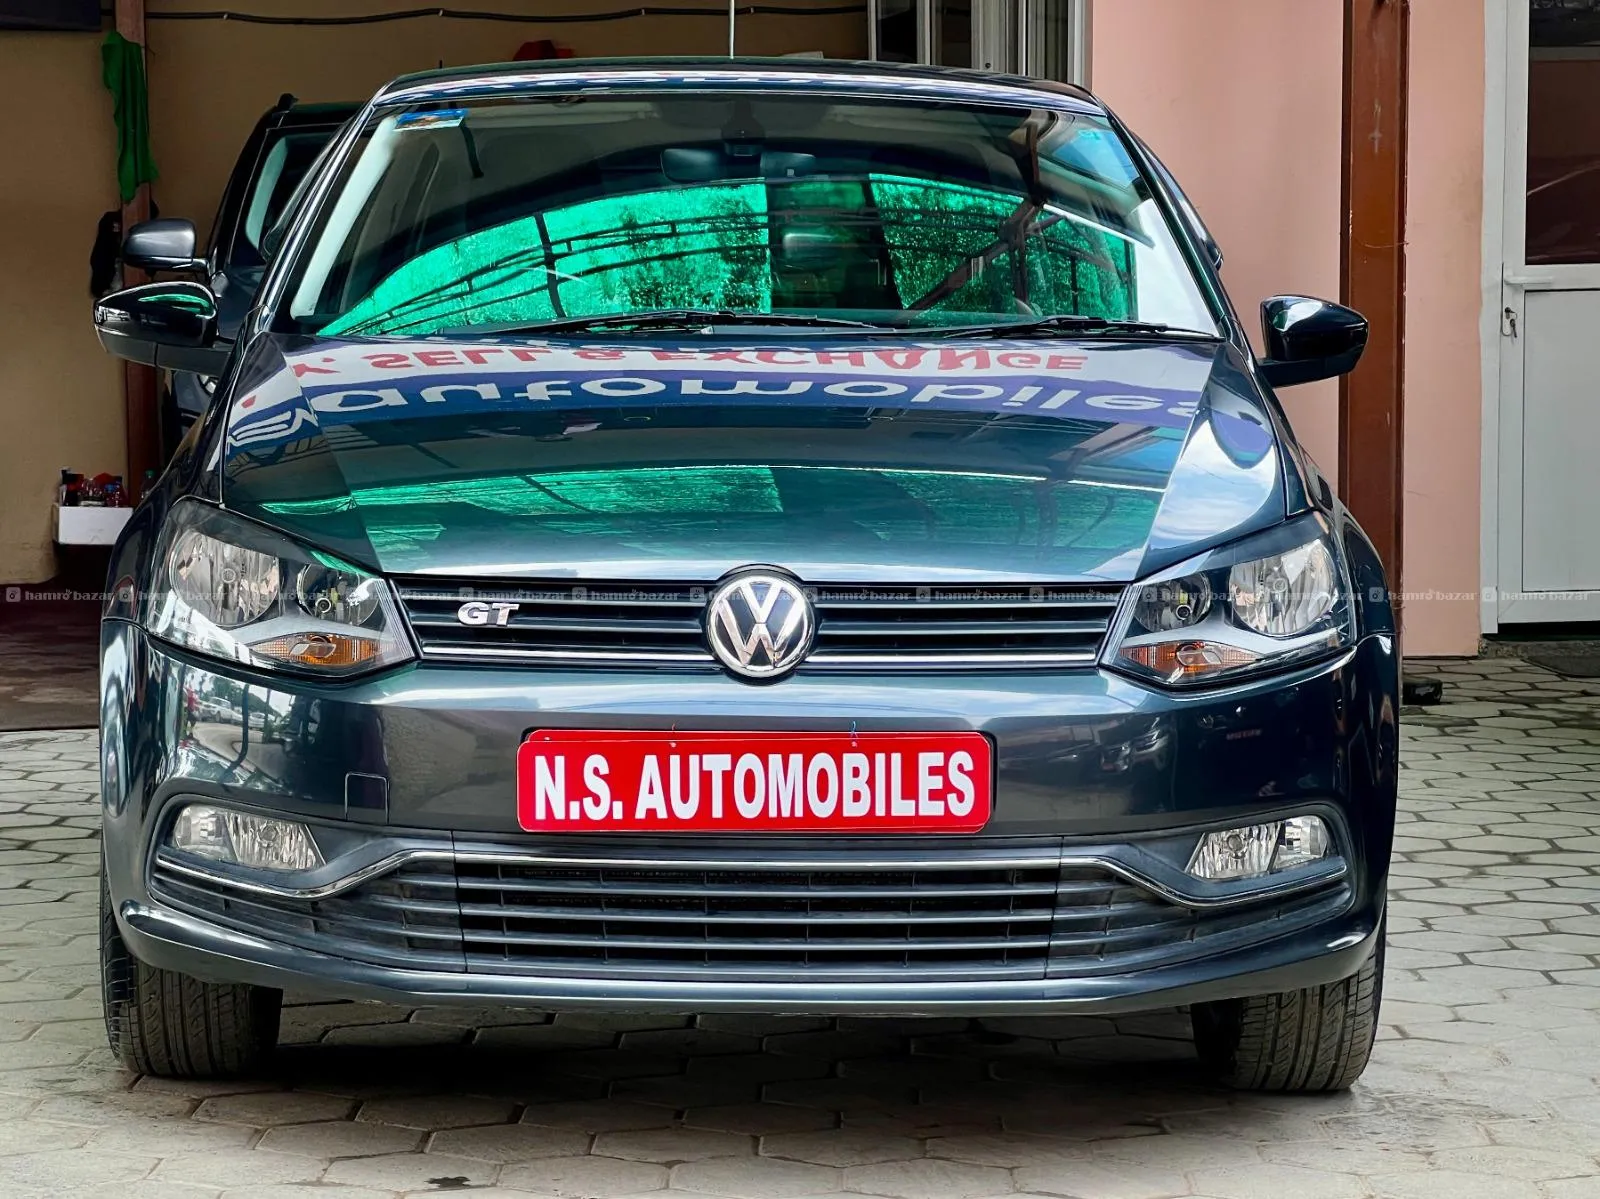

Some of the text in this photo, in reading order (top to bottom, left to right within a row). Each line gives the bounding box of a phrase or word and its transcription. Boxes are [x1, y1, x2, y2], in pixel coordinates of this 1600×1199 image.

[458, 601, 520, 625] GT
[534, 751, 975, 820] N.S. AUTOMOBILES
